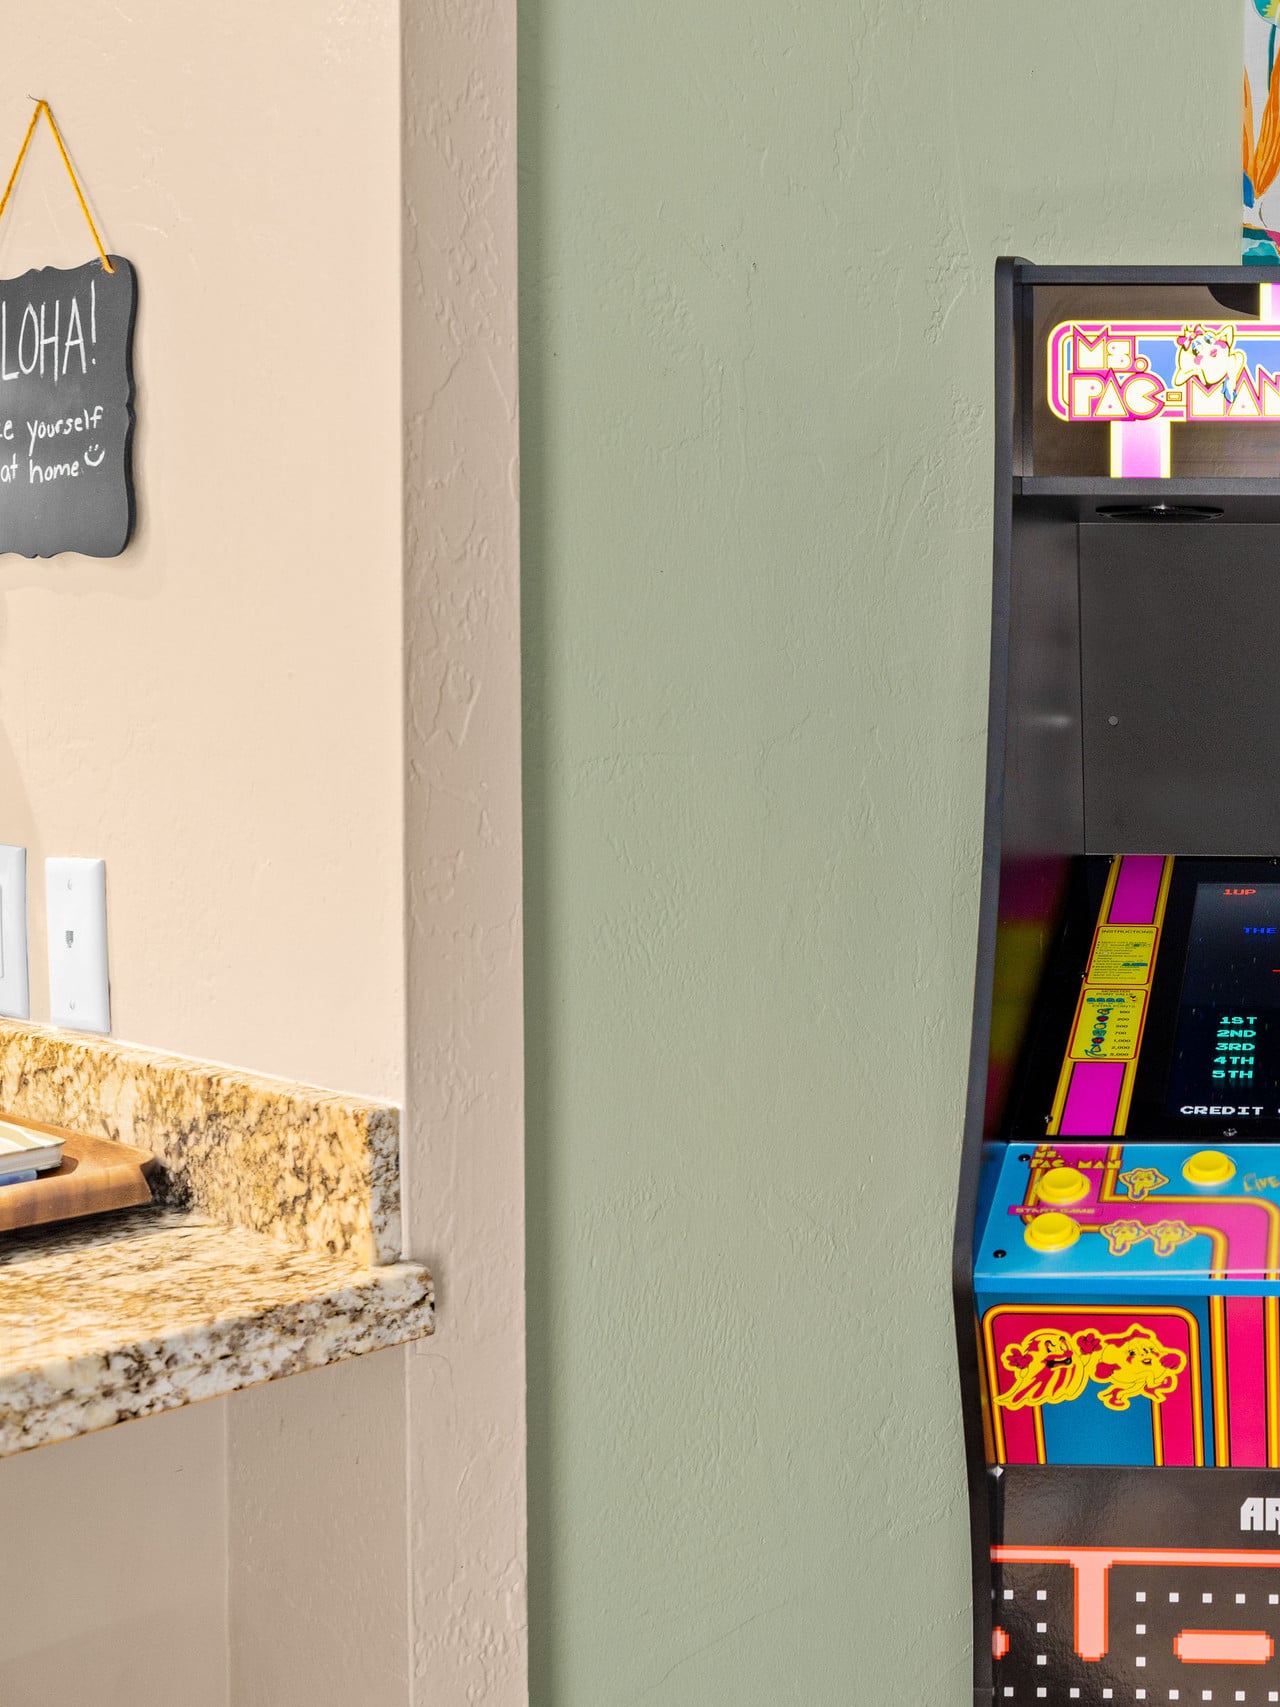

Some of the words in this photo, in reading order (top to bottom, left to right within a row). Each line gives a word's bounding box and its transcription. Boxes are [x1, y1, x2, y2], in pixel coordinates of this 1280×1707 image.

[27, 405, 104, 456] yourself
[1, 454, 18, 483] at
[29, 459, 79, 484] home
[1223, 888, 1257, 896] 1UP
[1243, 926, 1278, 935] THE
[1219, 1016, 1257, 1024] 1ST
[1216, 1029, 1257, 1038] 2ND
[1215, 1042, 1256, 1051] 3RD
[1213, 1056, 1255, 1065] 4TH
[1211, 1070, 1253, 1079] 5TH
[1180, 1105, 1264, 1115] CREDIT
